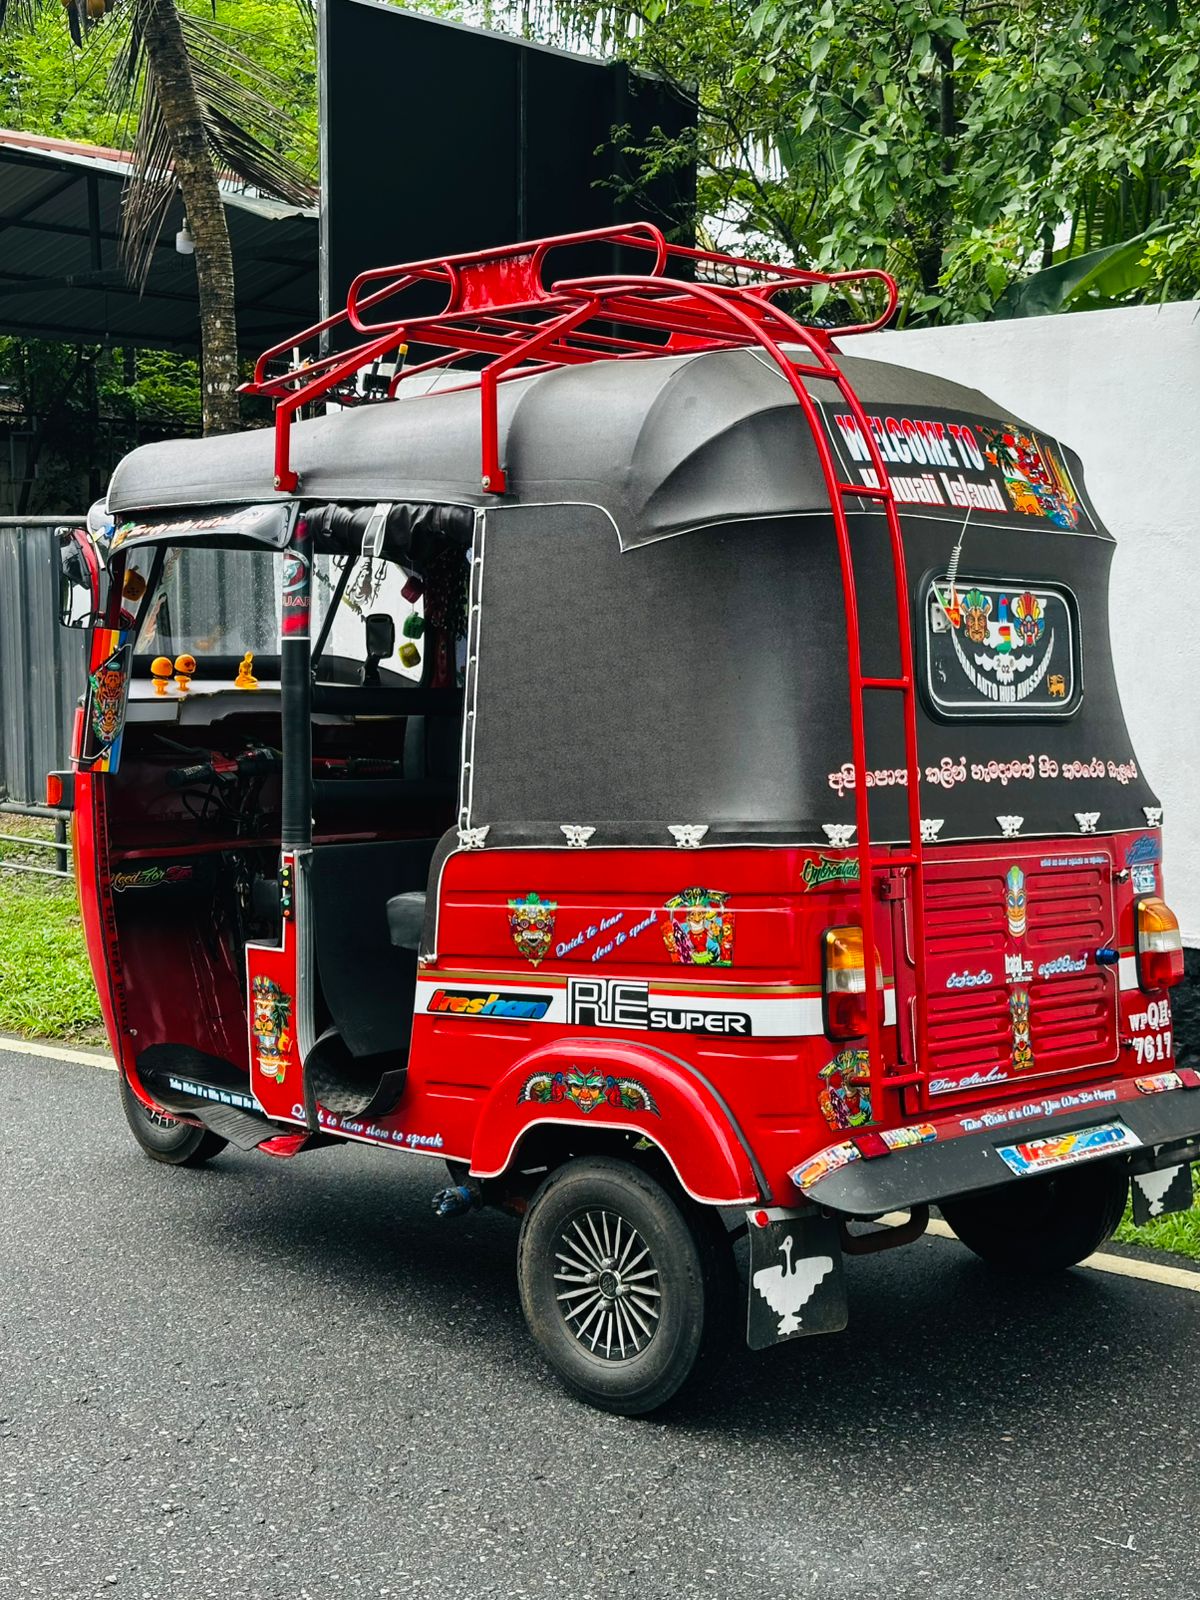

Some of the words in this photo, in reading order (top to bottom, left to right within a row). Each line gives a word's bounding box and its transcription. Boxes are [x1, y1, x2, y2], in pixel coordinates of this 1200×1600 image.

[833, 414, 960, 468] WELCOME
[946, 423, 986, 471] TO
[858, 468, 946, 506] Hwaii
[939, 472, 1008, 514] Island
[976, 672, 998, 701] AUTO
[999, 685, 1016, 702] HUB
[556, 931, 585, 957] Quick
[585, 925, 599, 939] to
[600, 912, 624, 932] hear
[592, 940, 614, 962] slow
[615, 932, 627, 946] to
[629, 909, 658, 937] speak
[568, 977, 648, 1030] RE
[650, 1010, 746, 1033] SUPER
[1132, 1031, 1171, 1065] 7617
[326, 1114, 337, 1126] to
[340, 1118, 363, 1133] hear
[365, 1124, 389, 1139] slow
[392, 1129, 403, 1142] to
[405, 1132, 443, 1149] speak
[960, 1118, 983, 1131] Take
[1041, 1100, 1061, 1116] You
